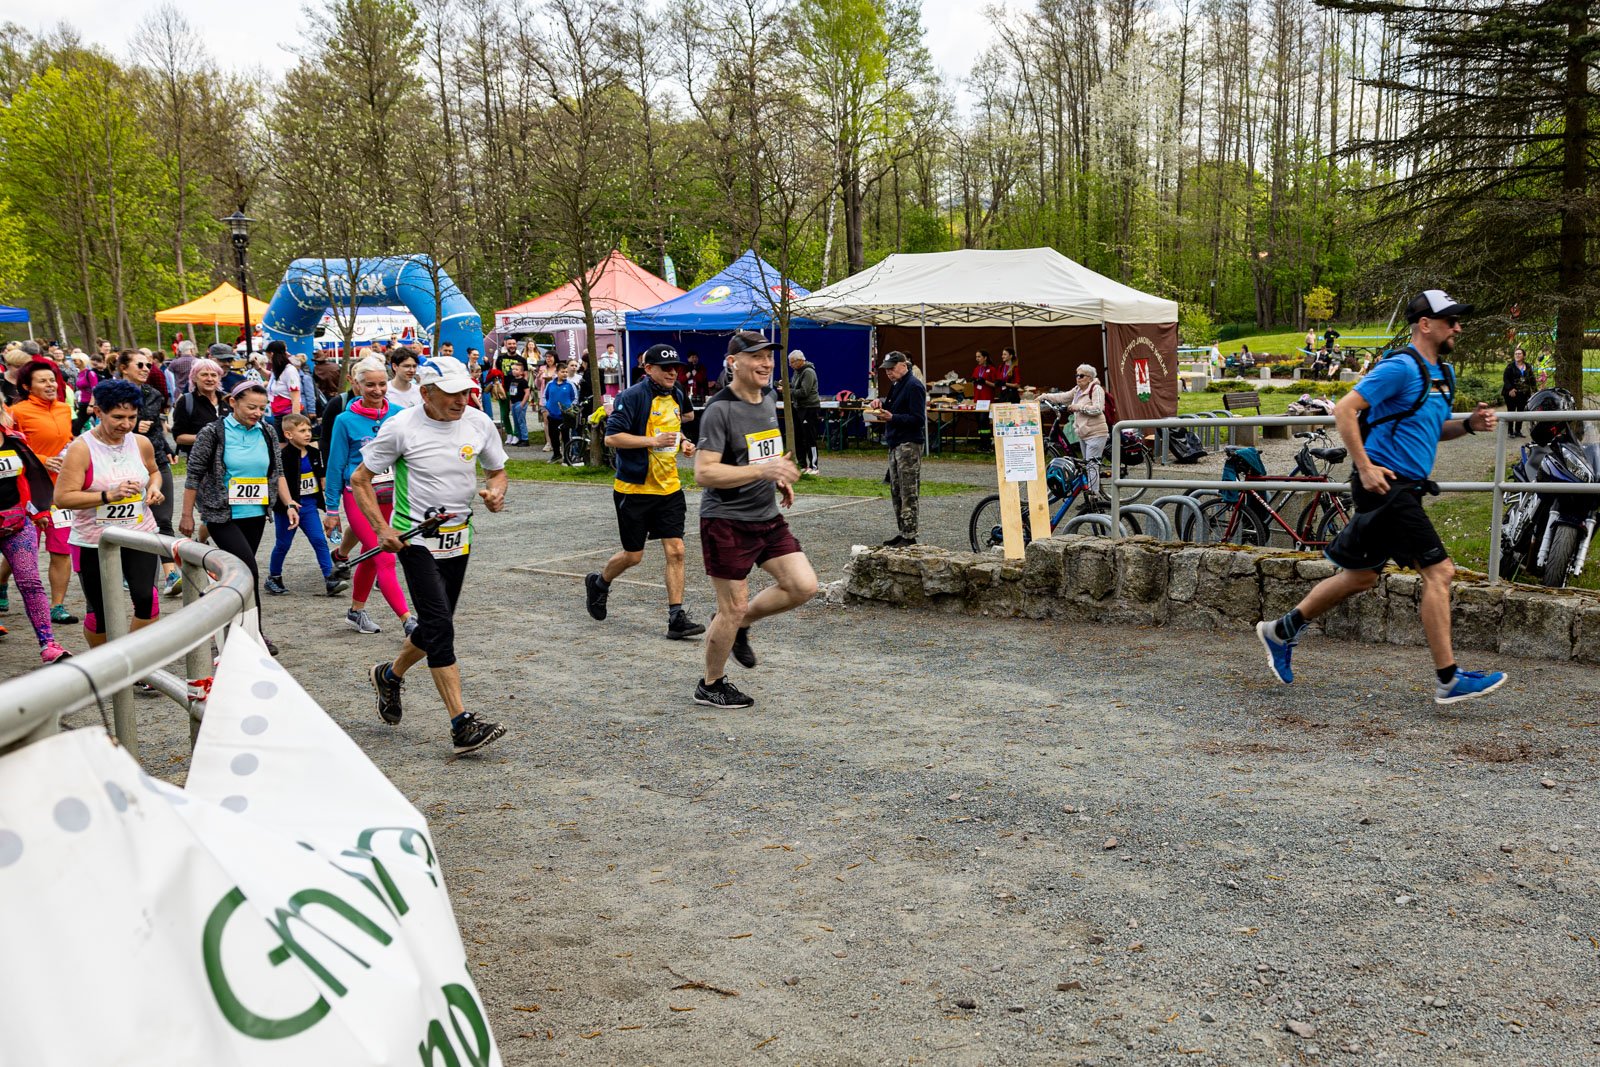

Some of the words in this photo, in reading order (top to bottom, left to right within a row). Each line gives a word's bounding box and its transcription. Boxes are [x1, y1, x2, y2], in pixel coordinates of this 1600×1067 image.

[757, 439, 774, 457] 187
[236, 485, 260, 497] 202
[106, 504, 135, 518] 222
[438, 532, 462, 550] 154
